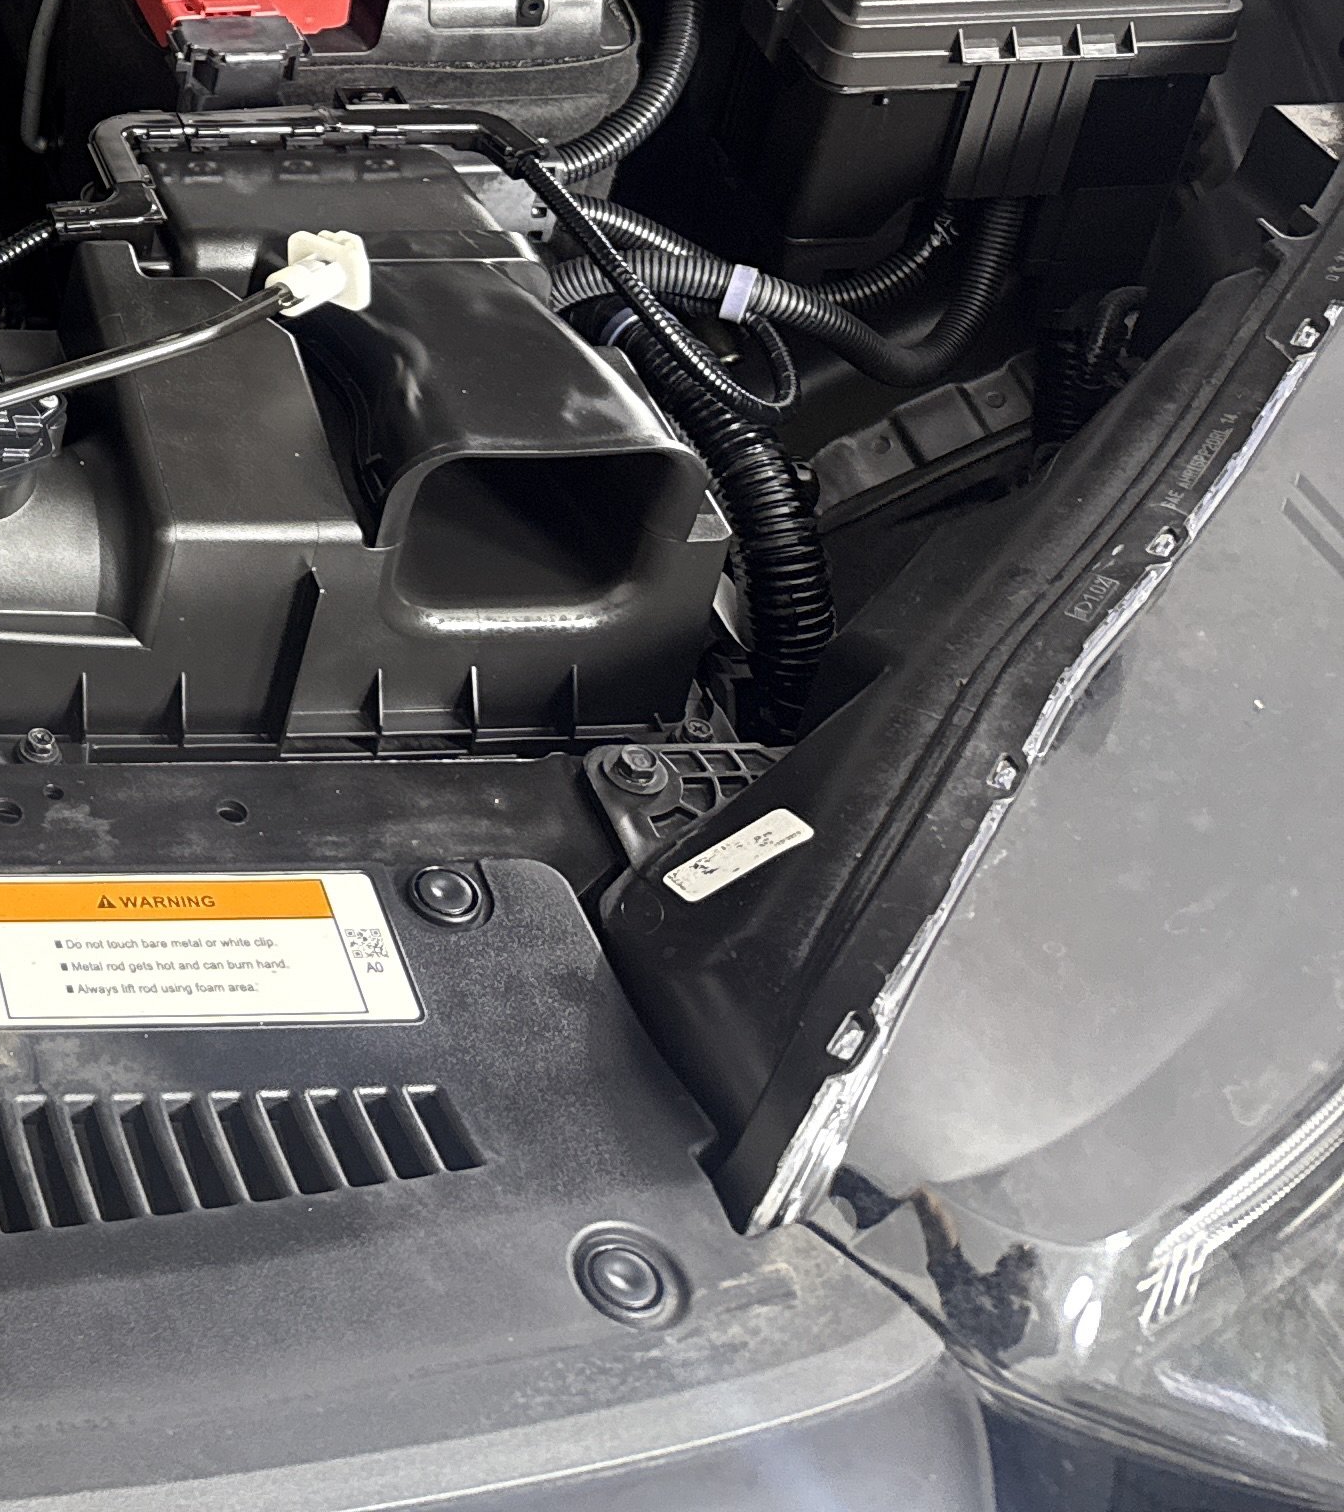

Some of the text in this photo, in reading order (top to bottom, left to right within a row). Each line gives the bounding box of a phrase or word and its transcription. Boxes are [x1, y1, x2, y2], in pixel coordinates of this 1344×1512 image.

[118, 895, 216, 909] WARNING
[65, 937, 278, 949] Do not touch bare metal or white clip.
[71, 961, 103, 972] Metal
[106, 961, 126, 971] rod
[128, 961, 154, 974] gets
[156, 960, 176, 971] hot
[178, 960, 200, 970] and
[203, 961, 224, 970] can
[227, 959, 254, 970] burn
[77, 984, 119, 996] Always
[121, 983, 136, 994] lift
[138, 983, 159, 993] rod
[161, 983, 193, 995] using
[195, 982, 225, 993] foam
